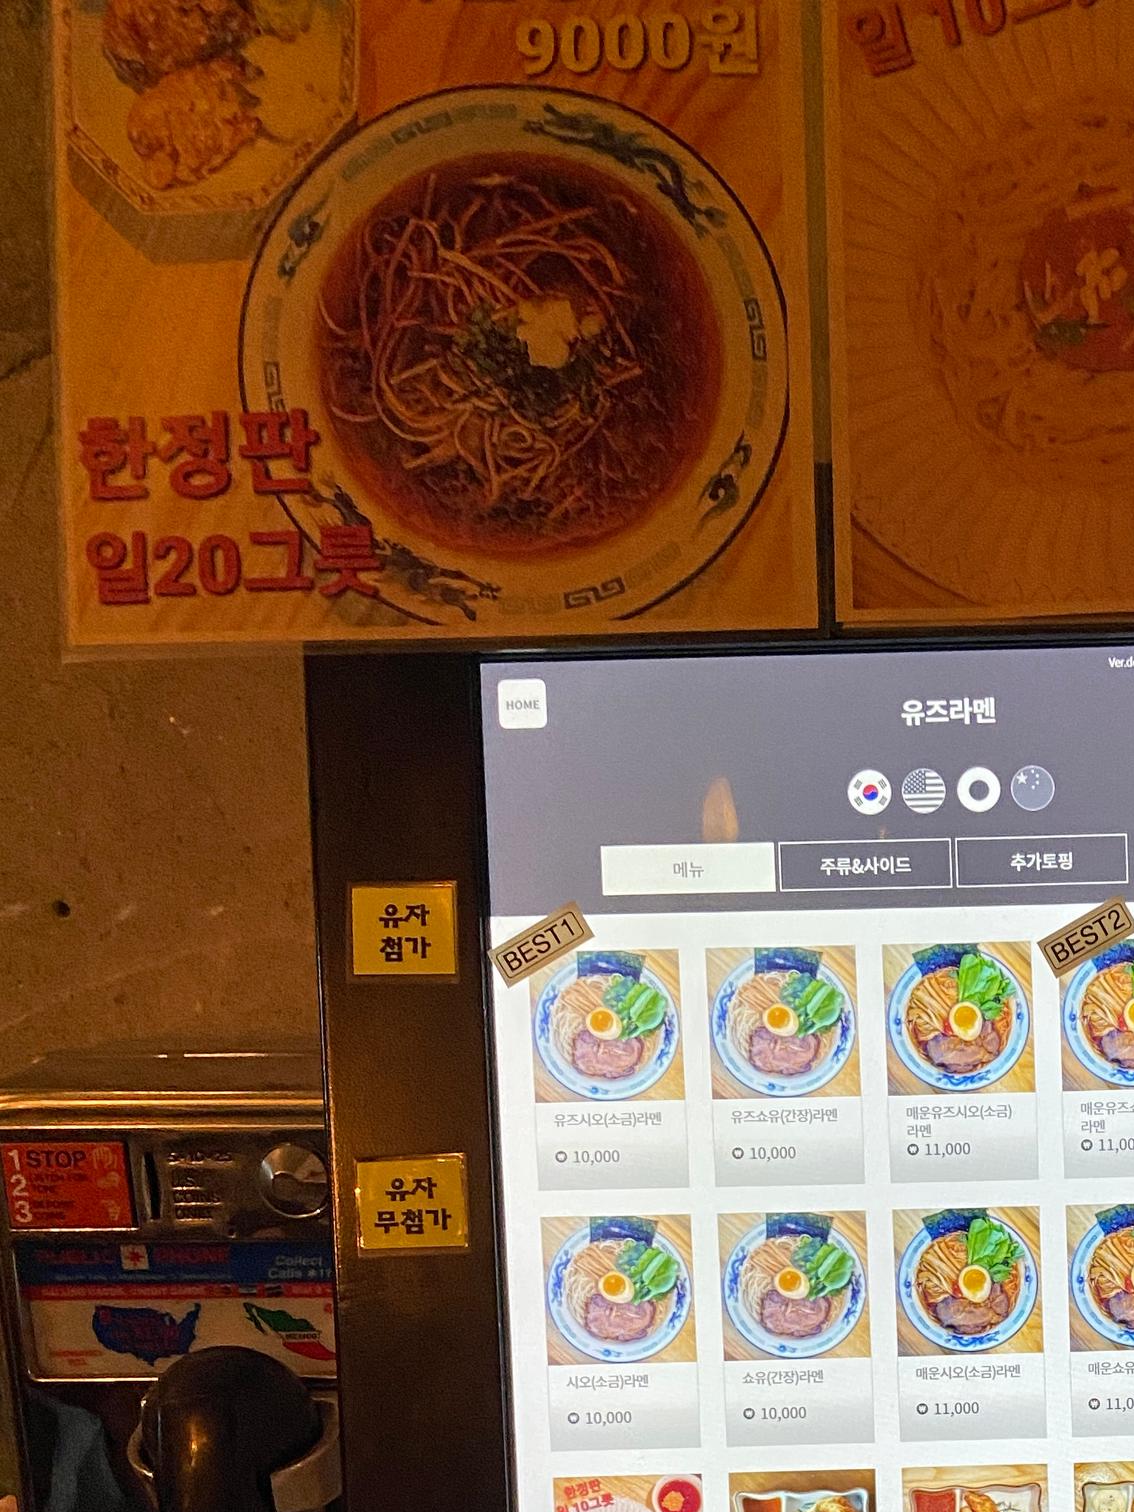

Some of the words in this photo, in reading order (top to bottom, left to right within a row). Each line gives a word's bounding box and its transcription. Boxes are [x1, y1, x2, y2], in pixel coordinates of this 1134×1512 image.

[515, 4, 762, 77] 9000원
[77, 408, 322, 502] 한정판
[85, 523, 382, 605] 일20그릇
[506, 699, 540, 711] HOME
[901, 696, 997, 726] 유즈라멘
[673, 860, 705, 878] 메뉴
[820, 855, 912, 876] 주류&사이드
[1010, 851, 1074, 872] 추가토핑
[379, 903, 429, 929] 유자
[502, 917, 577, 972] BEST1
[1050, 909, 1127, 964] BEST2
[379, 936, 432, 962] 첨가
[554, 1111, 662, 1128] 유즈시오(소금)라멘
[731, 1108, 837, 1125] 유즈쇼유(간장)라멘
[906, 1104, 1012, 1120] 매운유즈시오(소금)
[907, 1123, 932, 1138] 라멘
[1081, 1119, 1106, 1134] 라멘
[573, 1150, 620, 1165] 10,000
[749, 1146, 796, 1162] 10,000
[924, 1142, 971, 1158] 11,000
[26, 1150, 87, 1169] STOP
[385, 1176, 437, 1202] 유자
[374, 1207, 452, 1235] 무첨가
[742, 1369, 824, 1386] 쇼유(간장)라멘
[915, 1364, 1021, 1381] 매운시오(소금)라멘
[566, 1373, 649, 1390] 시오(소금)라멘
[585, 1411, 632, 1426] 10,000
[761, 1406, 807, 1422] 10,000
[934, 1402, 980, 1418] 11,000
